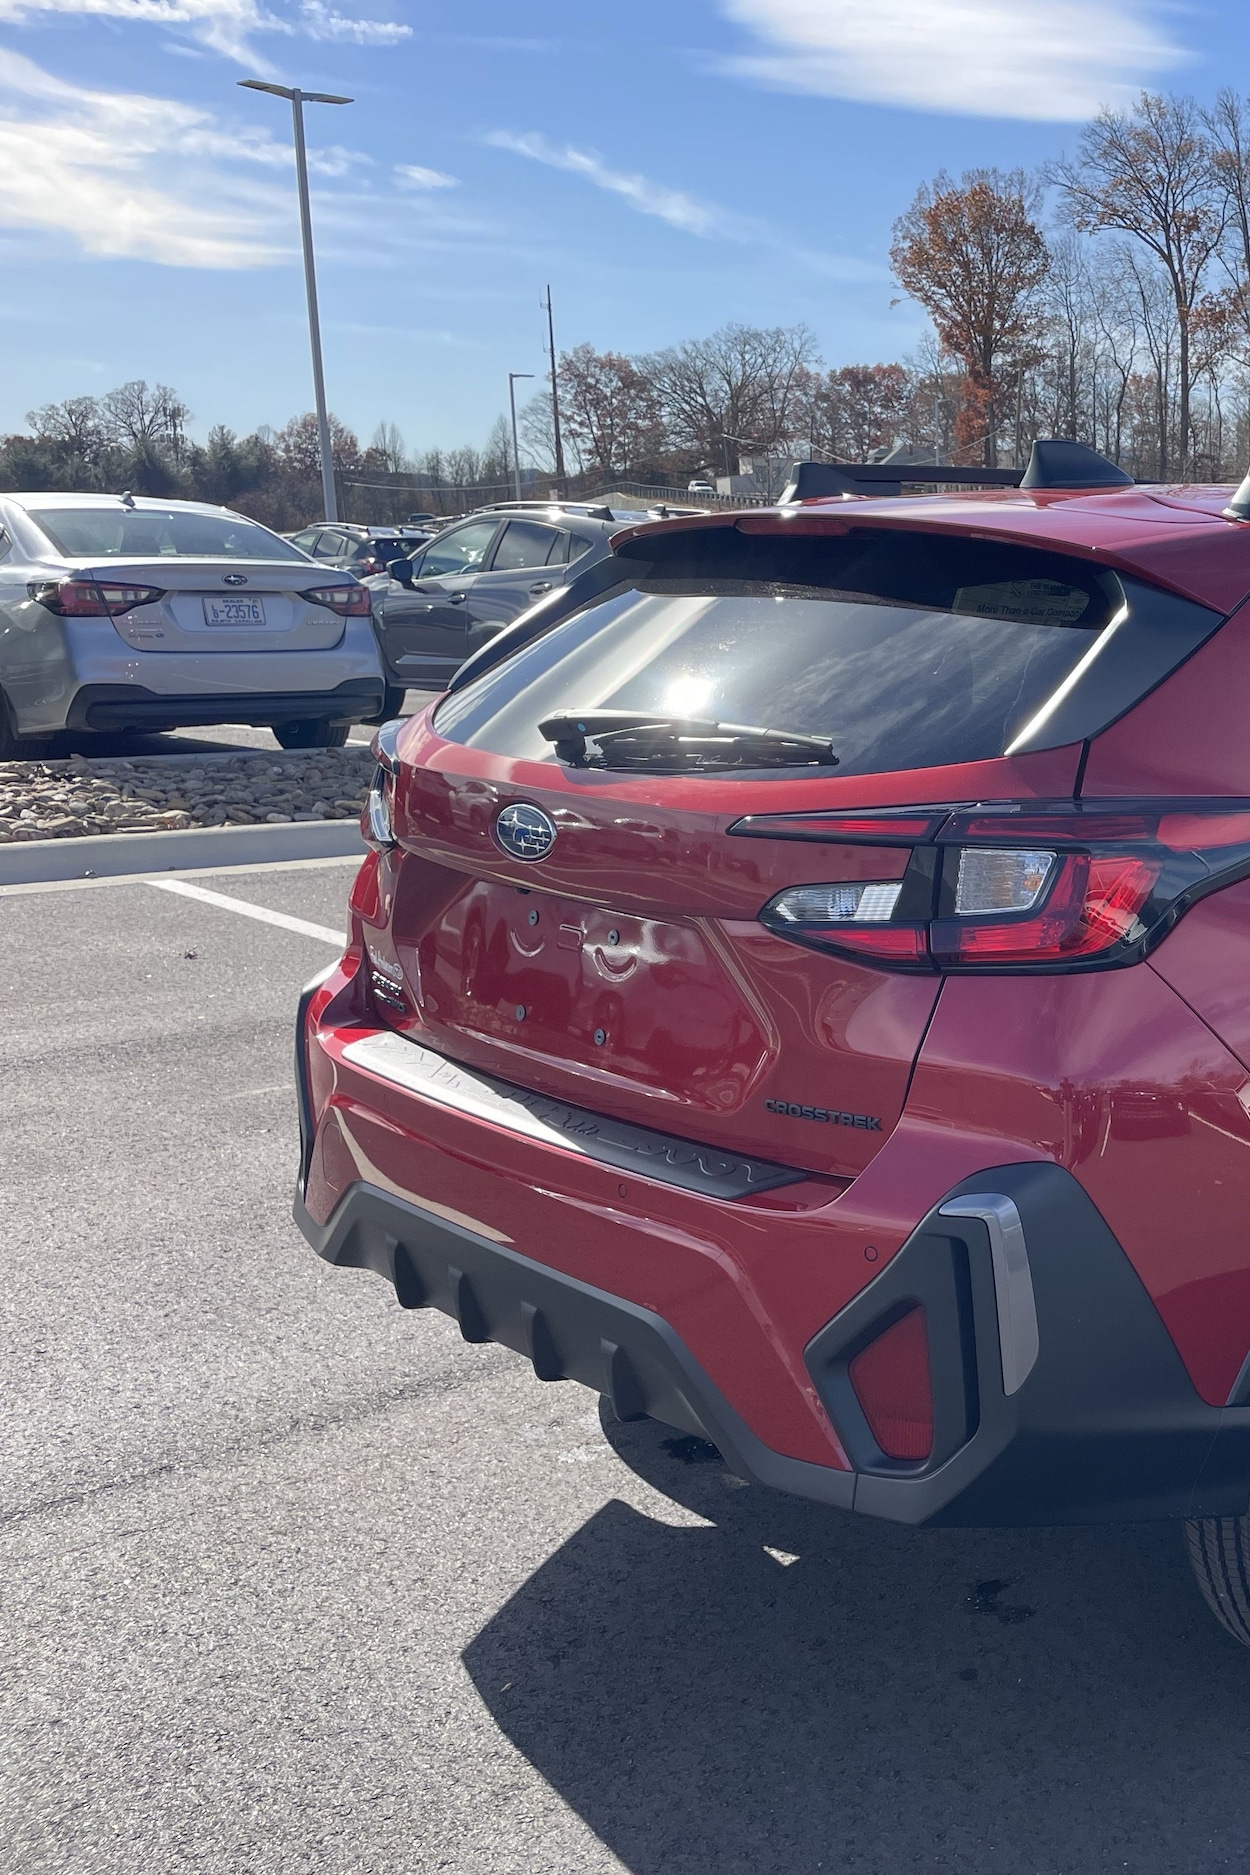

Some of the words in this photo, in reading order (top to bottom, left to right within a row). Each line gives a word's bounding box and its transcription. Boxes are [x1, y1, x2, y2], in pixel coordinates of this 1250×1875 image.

[976, 604, 998, 614] More
[1001, 606, 1021, 615] Than
[1031, 608, 1045, 616] Car
[764, 1098, 883, 1131] CROSSTREK
